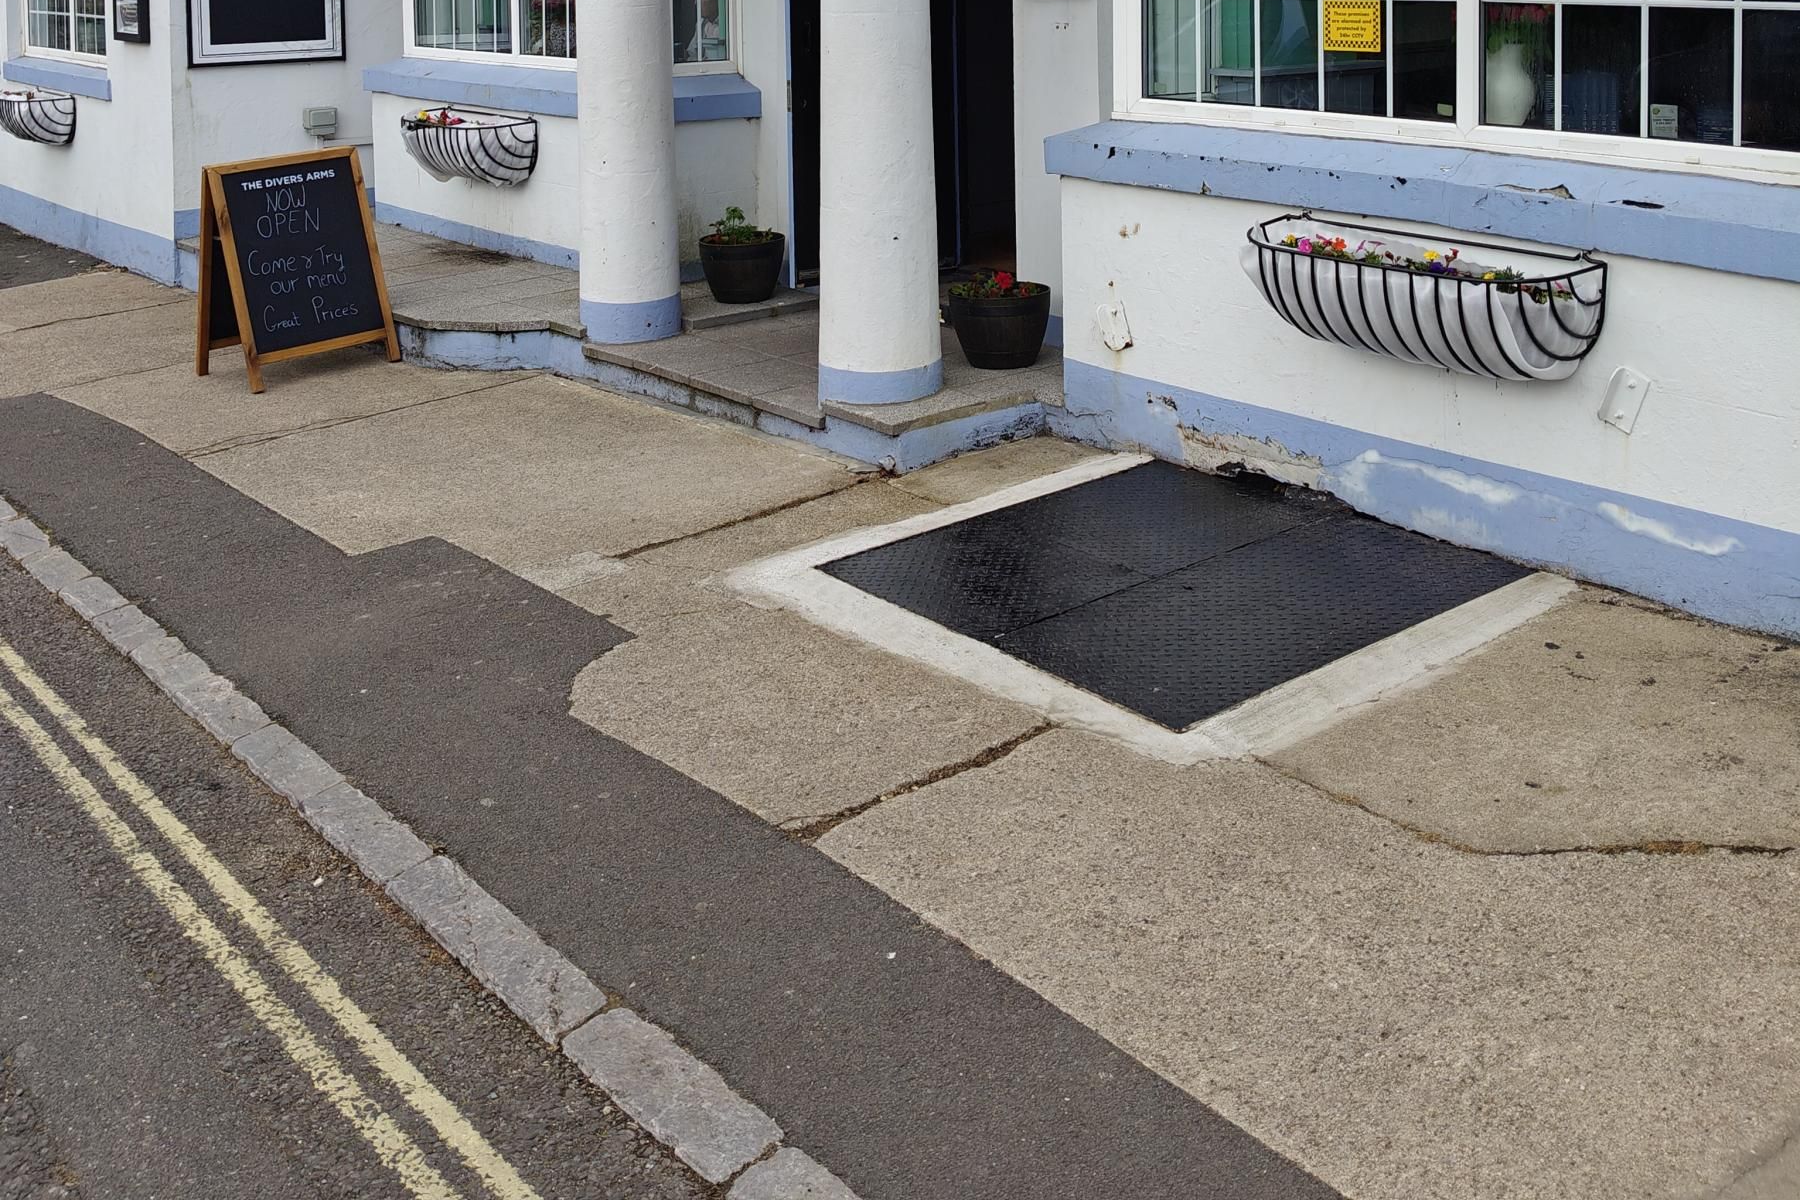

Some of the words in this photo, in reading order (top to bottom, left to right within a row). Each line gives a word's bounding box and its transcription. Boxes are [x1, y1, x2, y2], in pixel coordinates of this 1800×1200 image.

[241, 180, 263, 191] THE
[265, 174, 304, 188] DIVERS
[305, 169, 336, 182] ARMS
[266, 184, 306, 213] NOW
[256, 208, 320, 238] OPEN
[248, 250, 297, 276] Come
[314, 244, 345, 272] Try
[270, 277, 299, 295] our
[307, 272, 347, 288] menu
[263, 305, 301, 332] Great
[311, 295, 359, 324] Prices
